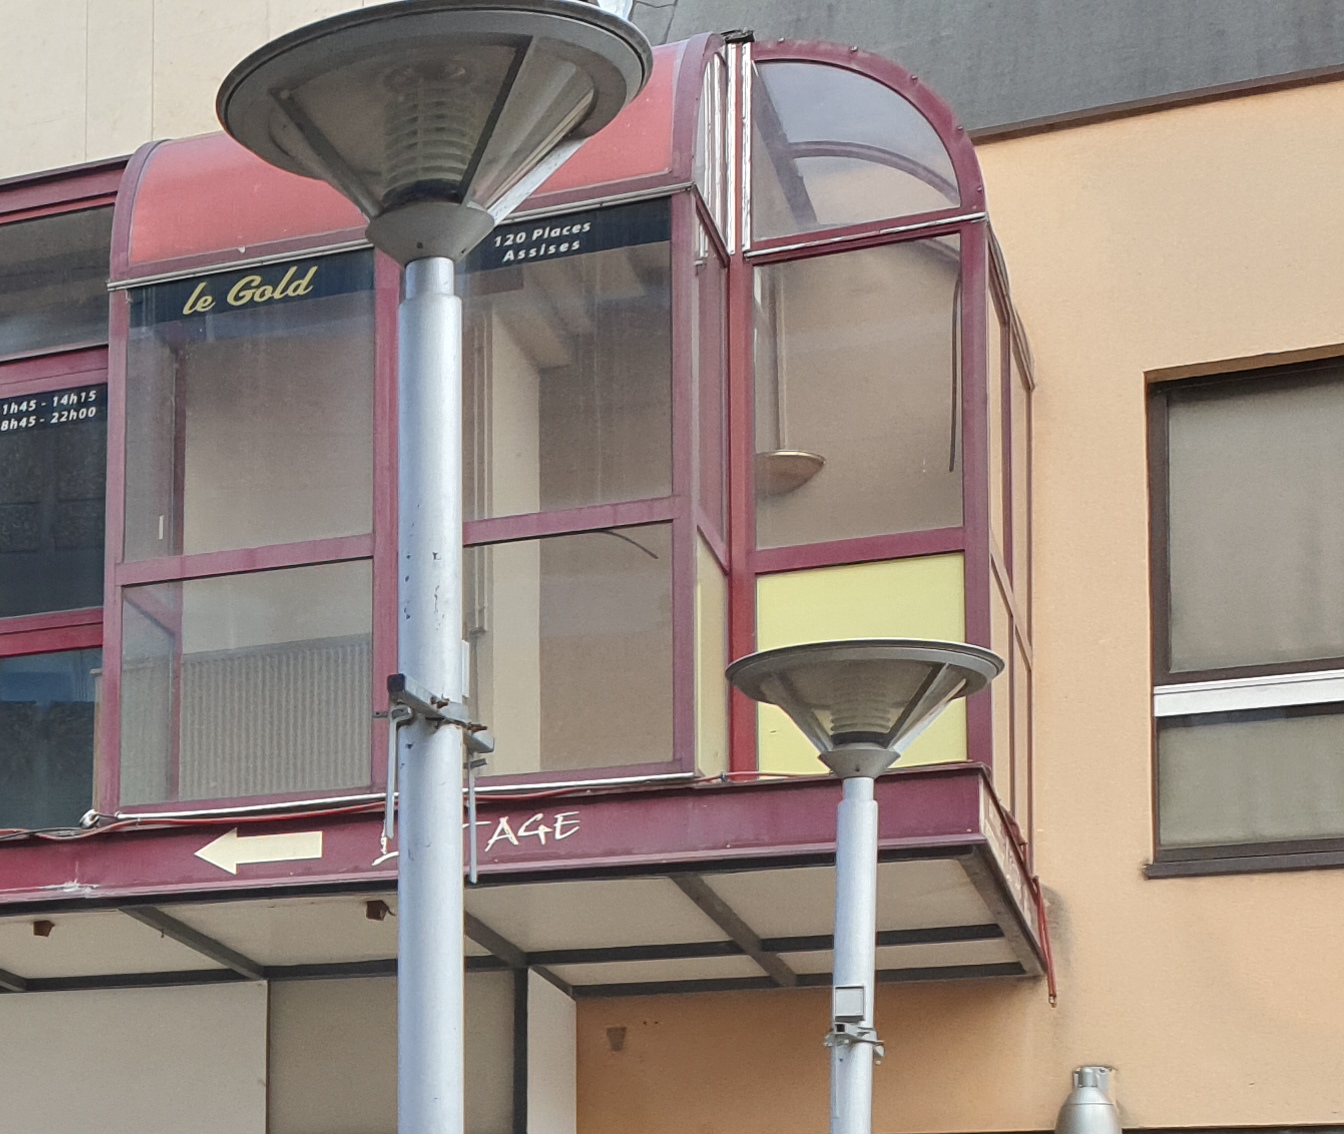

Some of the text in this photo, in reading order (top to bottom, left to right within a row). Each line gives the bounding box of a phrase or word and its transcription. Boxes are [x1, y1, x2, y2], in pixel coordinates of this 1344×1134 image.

[494, 222, 591, 247] 120 Places
[502, 240, 580, 263] Assises
[183, 265, 318, 315] le Gold
[52, 390, 97, 407] 14h15
[50, 406, 96, 424] 22h00
